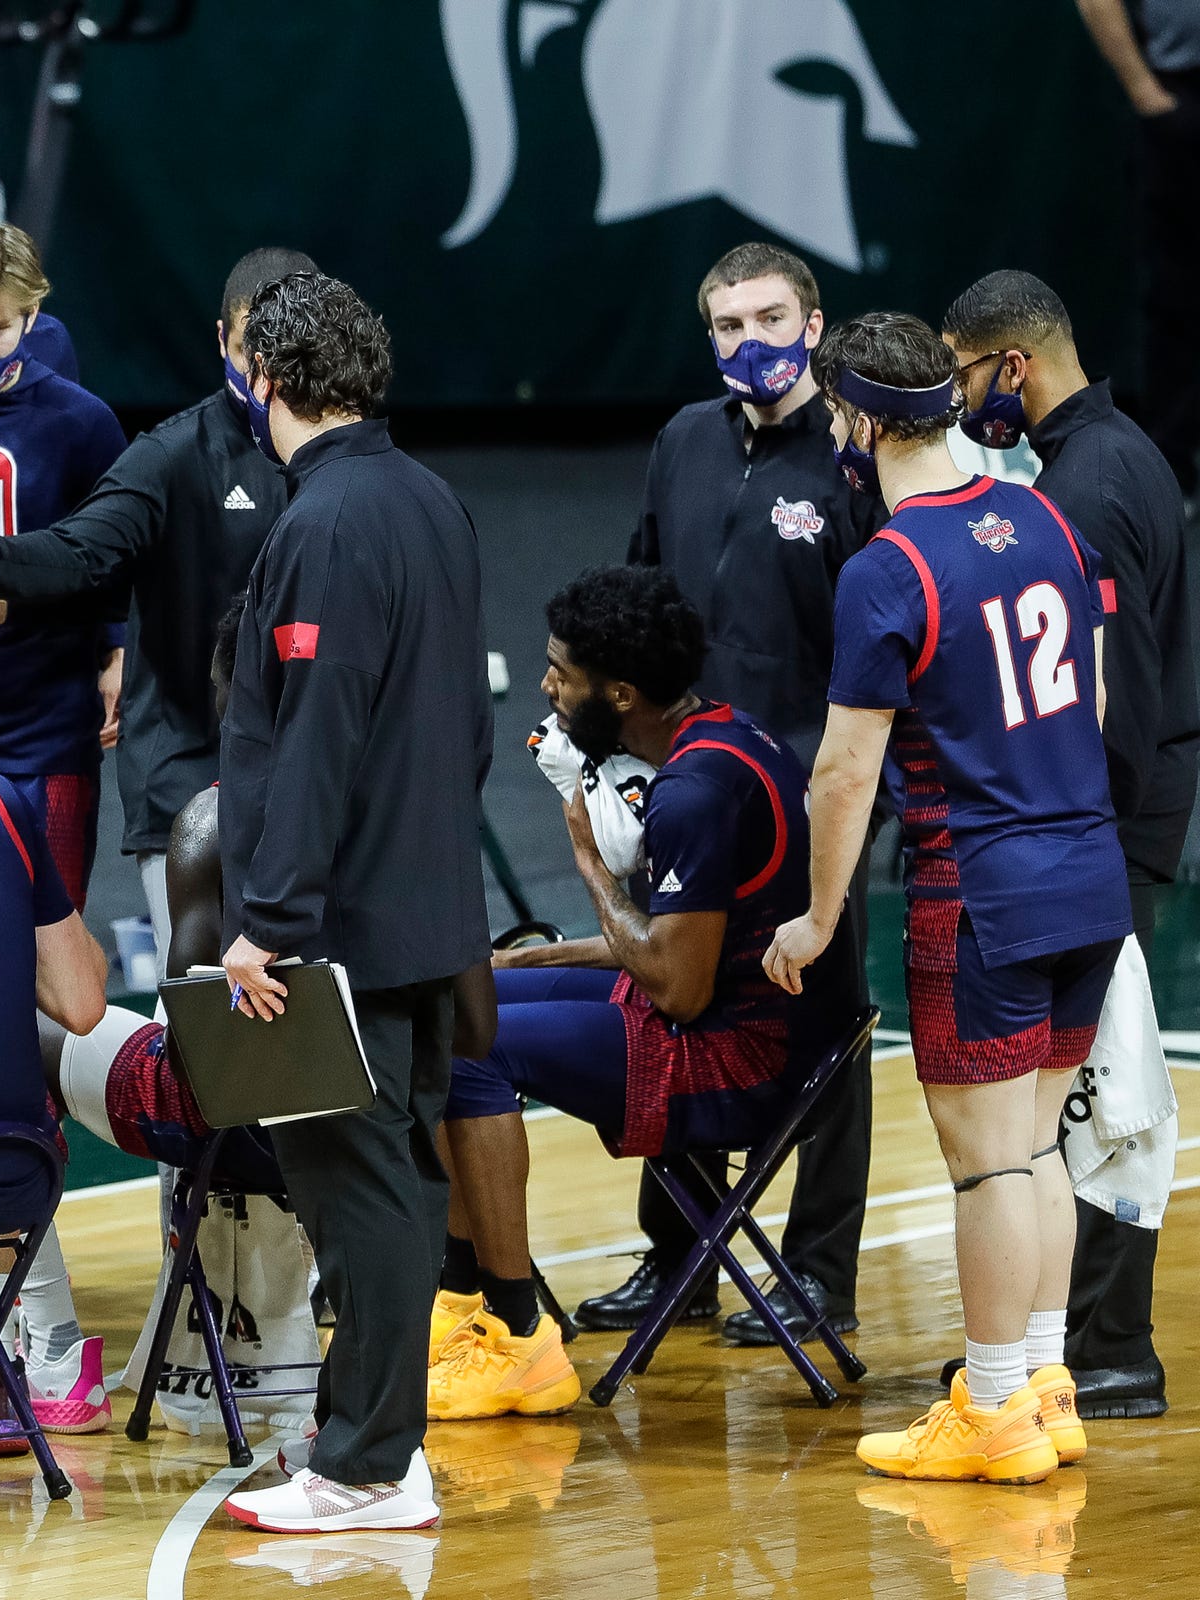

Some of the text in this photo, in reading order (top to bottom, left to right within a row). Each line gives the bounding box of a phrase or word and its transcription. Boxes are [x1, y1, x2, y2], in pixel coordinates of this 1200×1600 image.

[224, 500, 256, 510] adidas
[772, 506, 823, 532] TITANS
[972, 520, 1014, 545] TITANS
[979, 579, 1081, 732] 12
